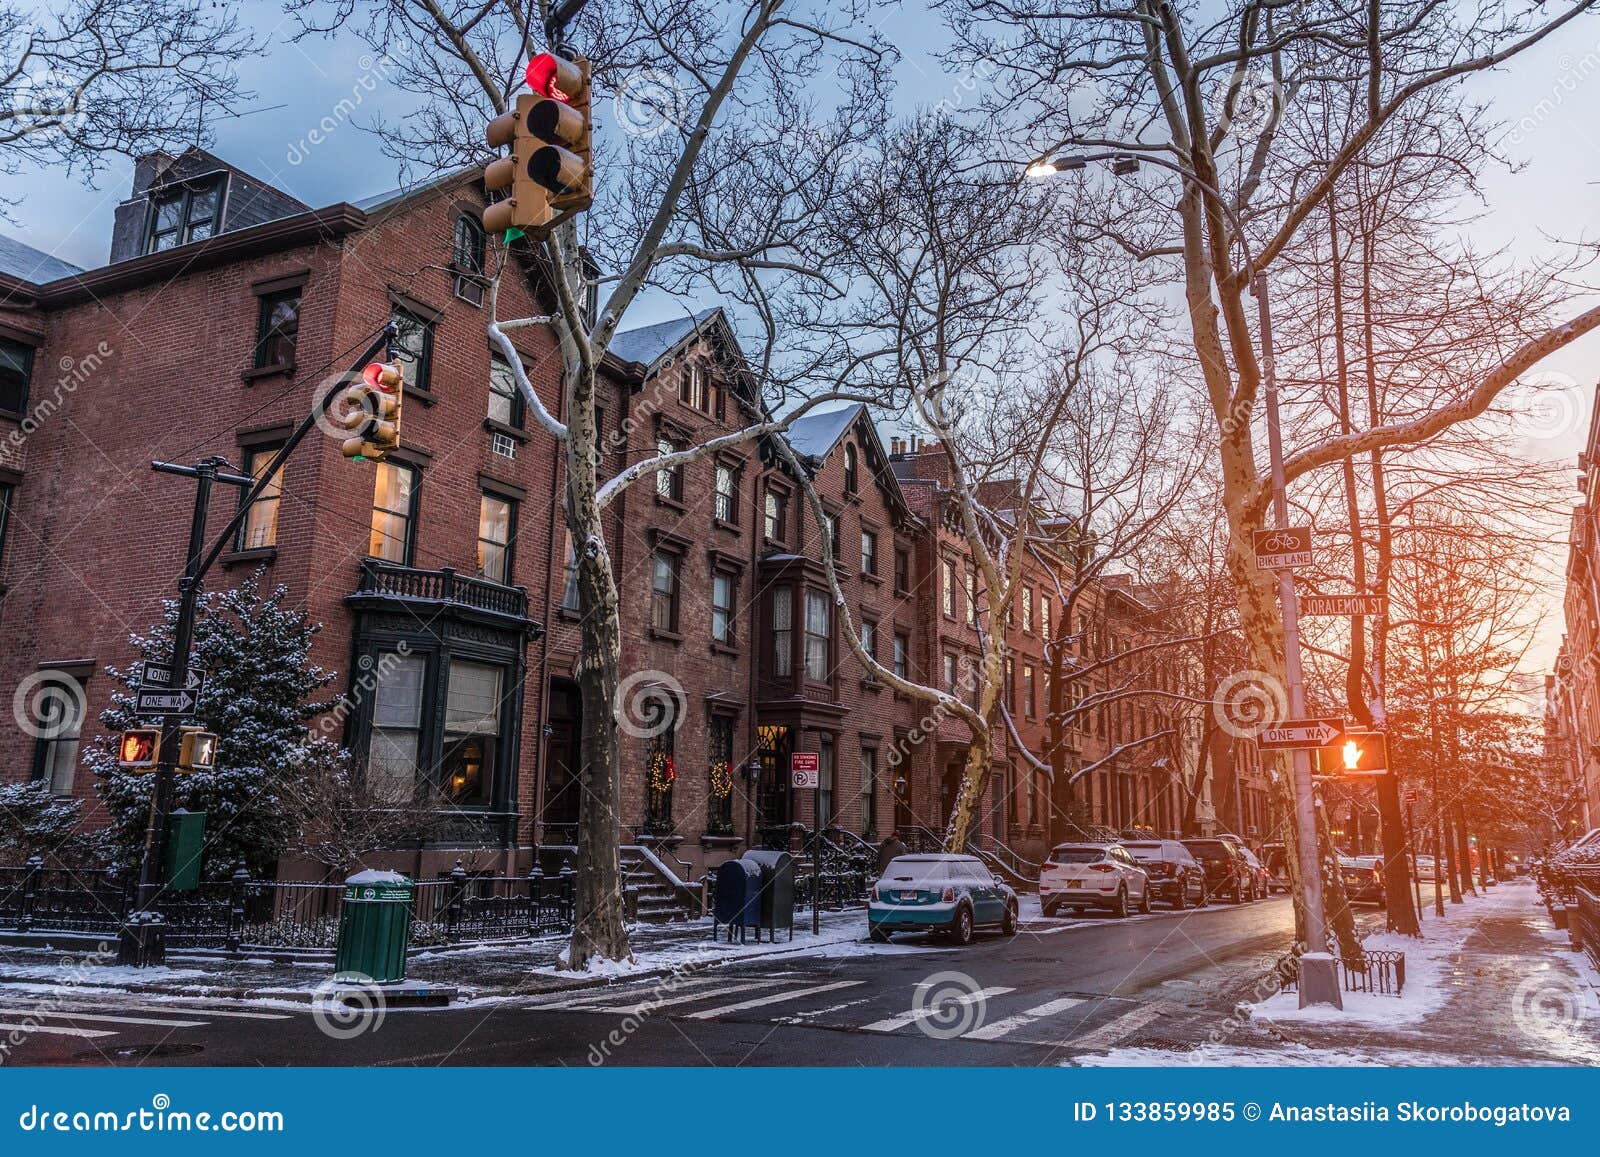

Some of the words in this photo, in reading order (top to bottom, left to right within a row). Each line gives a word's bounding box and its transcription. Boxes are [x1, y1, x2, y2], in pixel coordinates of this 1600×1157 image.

[1258, 555, 1279, 567] BIKE
[1284, 553, 1310, 565] LANE
[1306, 598, 1366, 615] JORALEMON
[1371, 597, 1383, 613] ST
[145, 696, 163, 707] ONE
[170, 696, 188, 707] WAY
[1268, 729, 1294, 741] ONE
[1305, 728, 1331, 739] WAY
